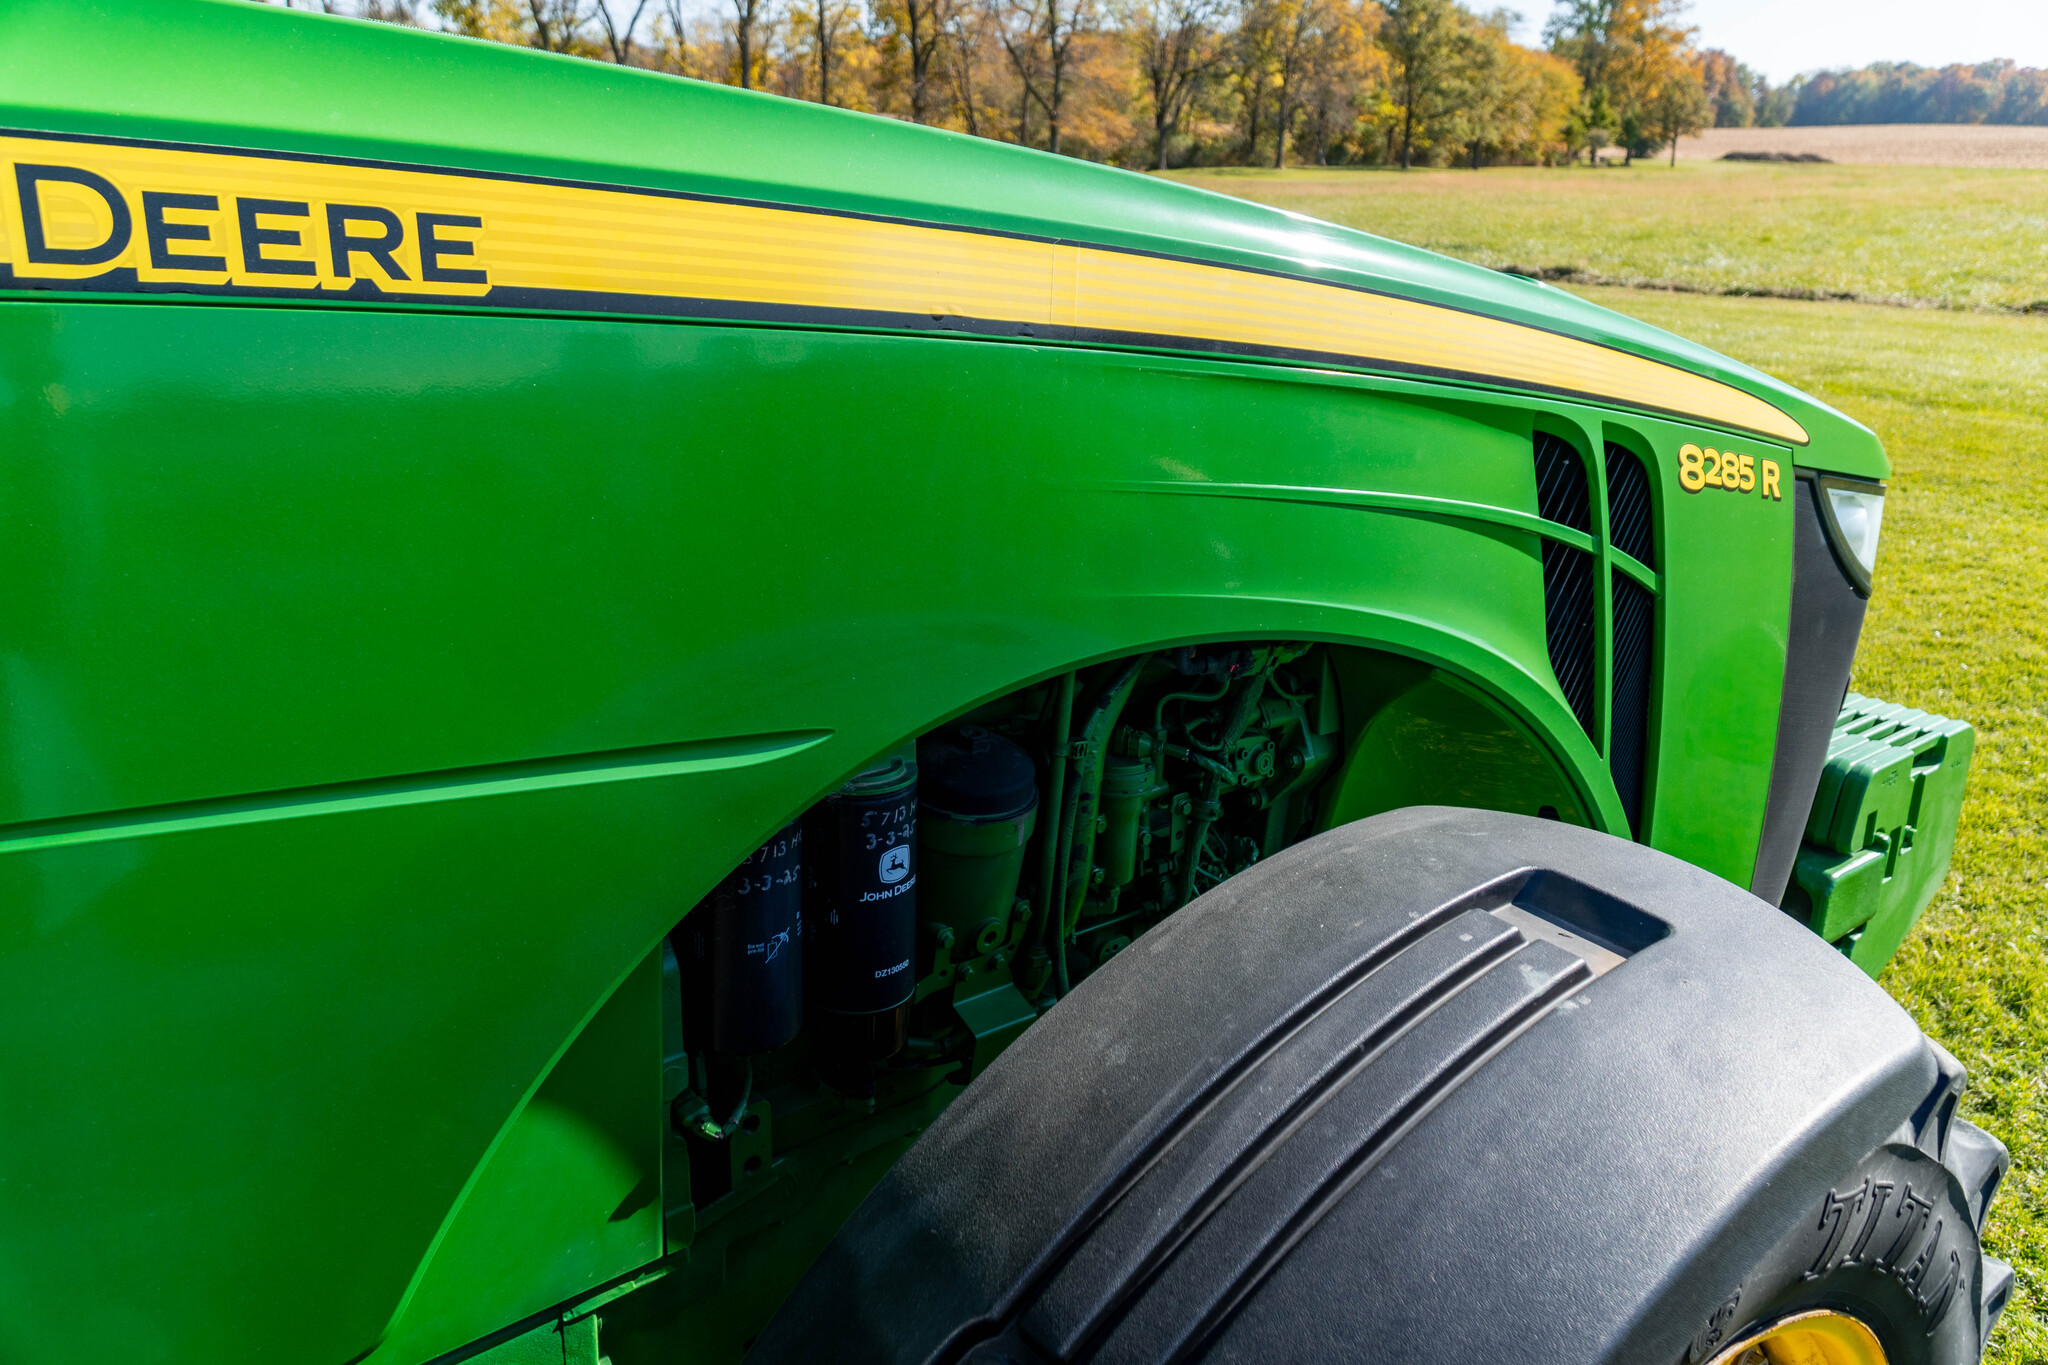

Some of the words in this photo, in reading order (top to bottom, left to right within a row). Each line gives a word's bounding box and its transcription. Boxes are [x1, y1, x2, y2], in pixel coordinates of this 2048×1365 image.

[13, 162, 490, 288] DEERE
[1678, 443, 1756, 494] 8285
[1761, 458, 1781, 502] R
[859, 889, 892, 902] JOHN
[1804, 1175, 1966, 1337] TITAN
